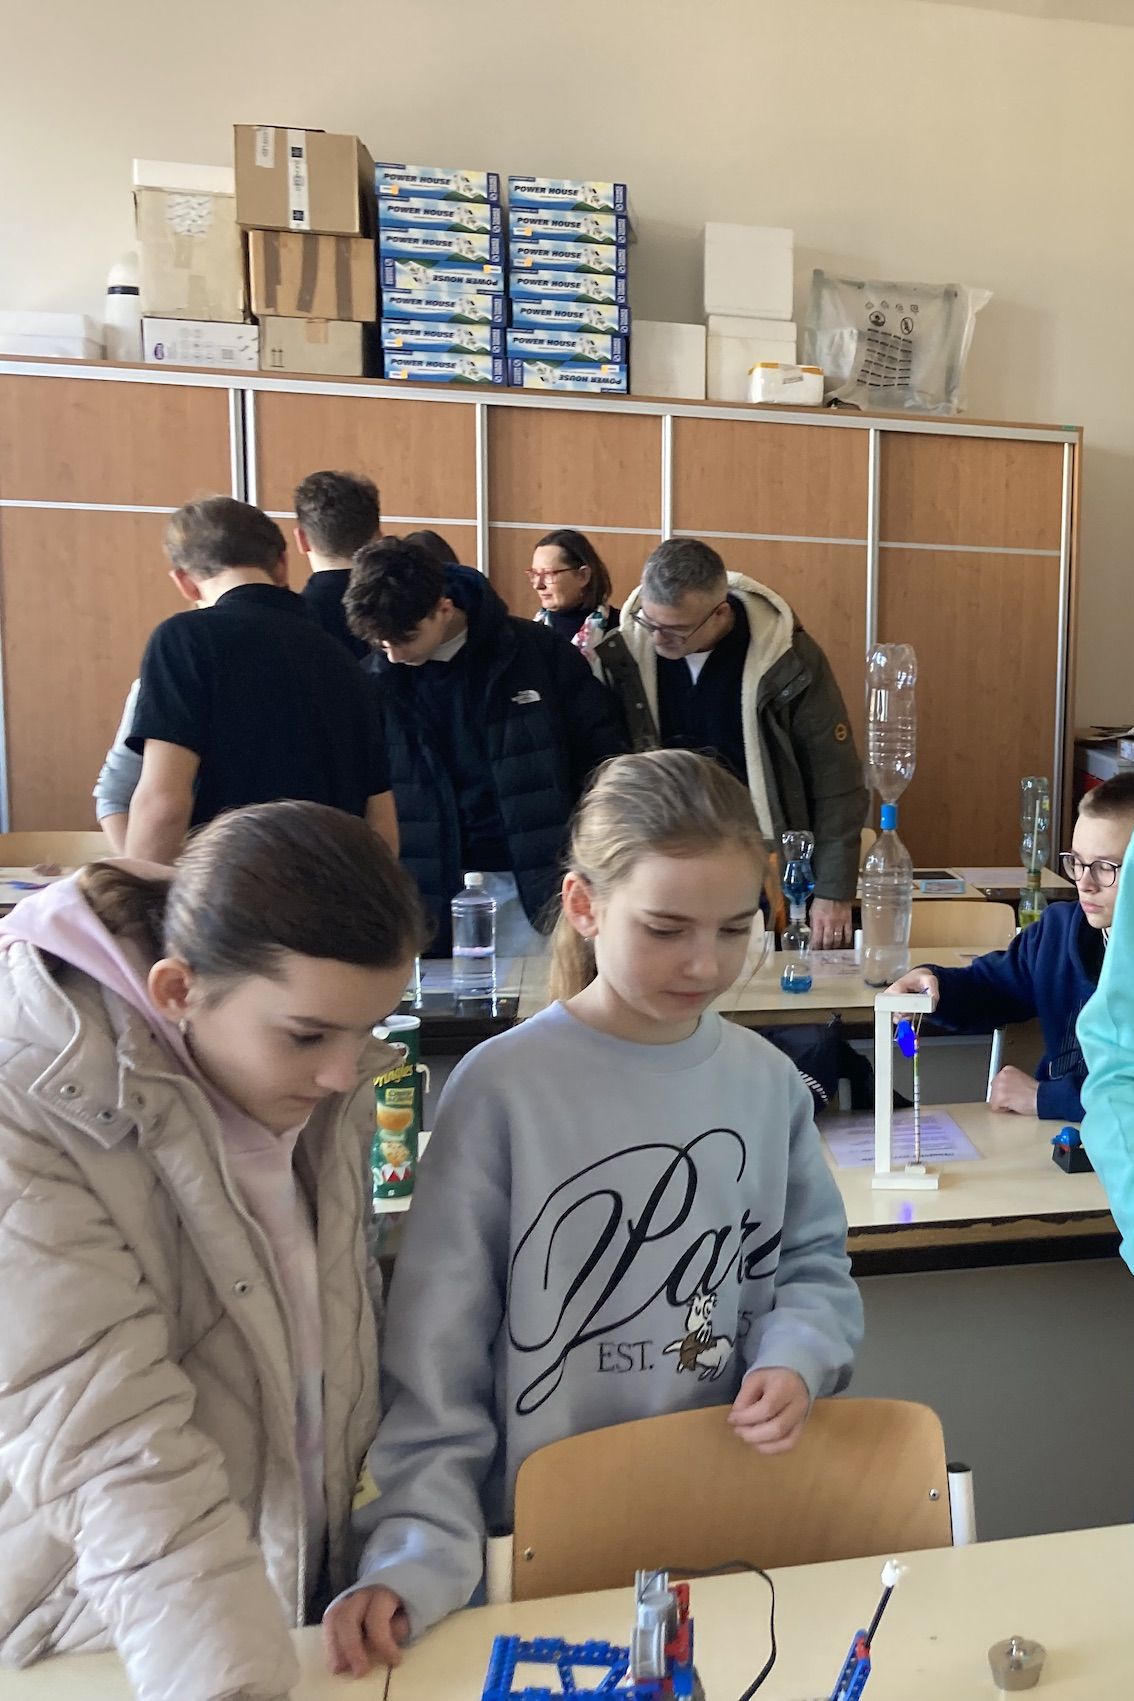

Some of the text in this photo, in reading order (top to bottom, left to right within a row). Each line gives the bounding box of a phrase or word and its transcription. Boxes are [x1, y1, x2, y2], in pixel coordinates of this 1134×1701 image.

[384, 173, 451, 184] POWER HOUSE
[514, 185, 579, 196] POWER HOUSE
[387, 205, 455, 217] POWER HOUSE
[517, 217, 581, 228] POWER HOUSE
[386, 235, 453, 247] POWER HOUSE
[518, 248, 581, 258] POWER HOUSE
[433, 274, 498, 285] POWER HOUSE
[517, 278, 581, 288] POWER HOUSE
[390, 297, 456, 307] POWER HOUSE
[520, 308, 584, 318] POWER HOUSE
[388, 328, 454, 338] POWER HOUSE
[512, 337, 577, 347] POWER HOUSE
[391, 358, 456, 368] POWER HOUSE
[559, 374, 588, 382] HOUSE
[597, 1340, 654, 1373] EST.
